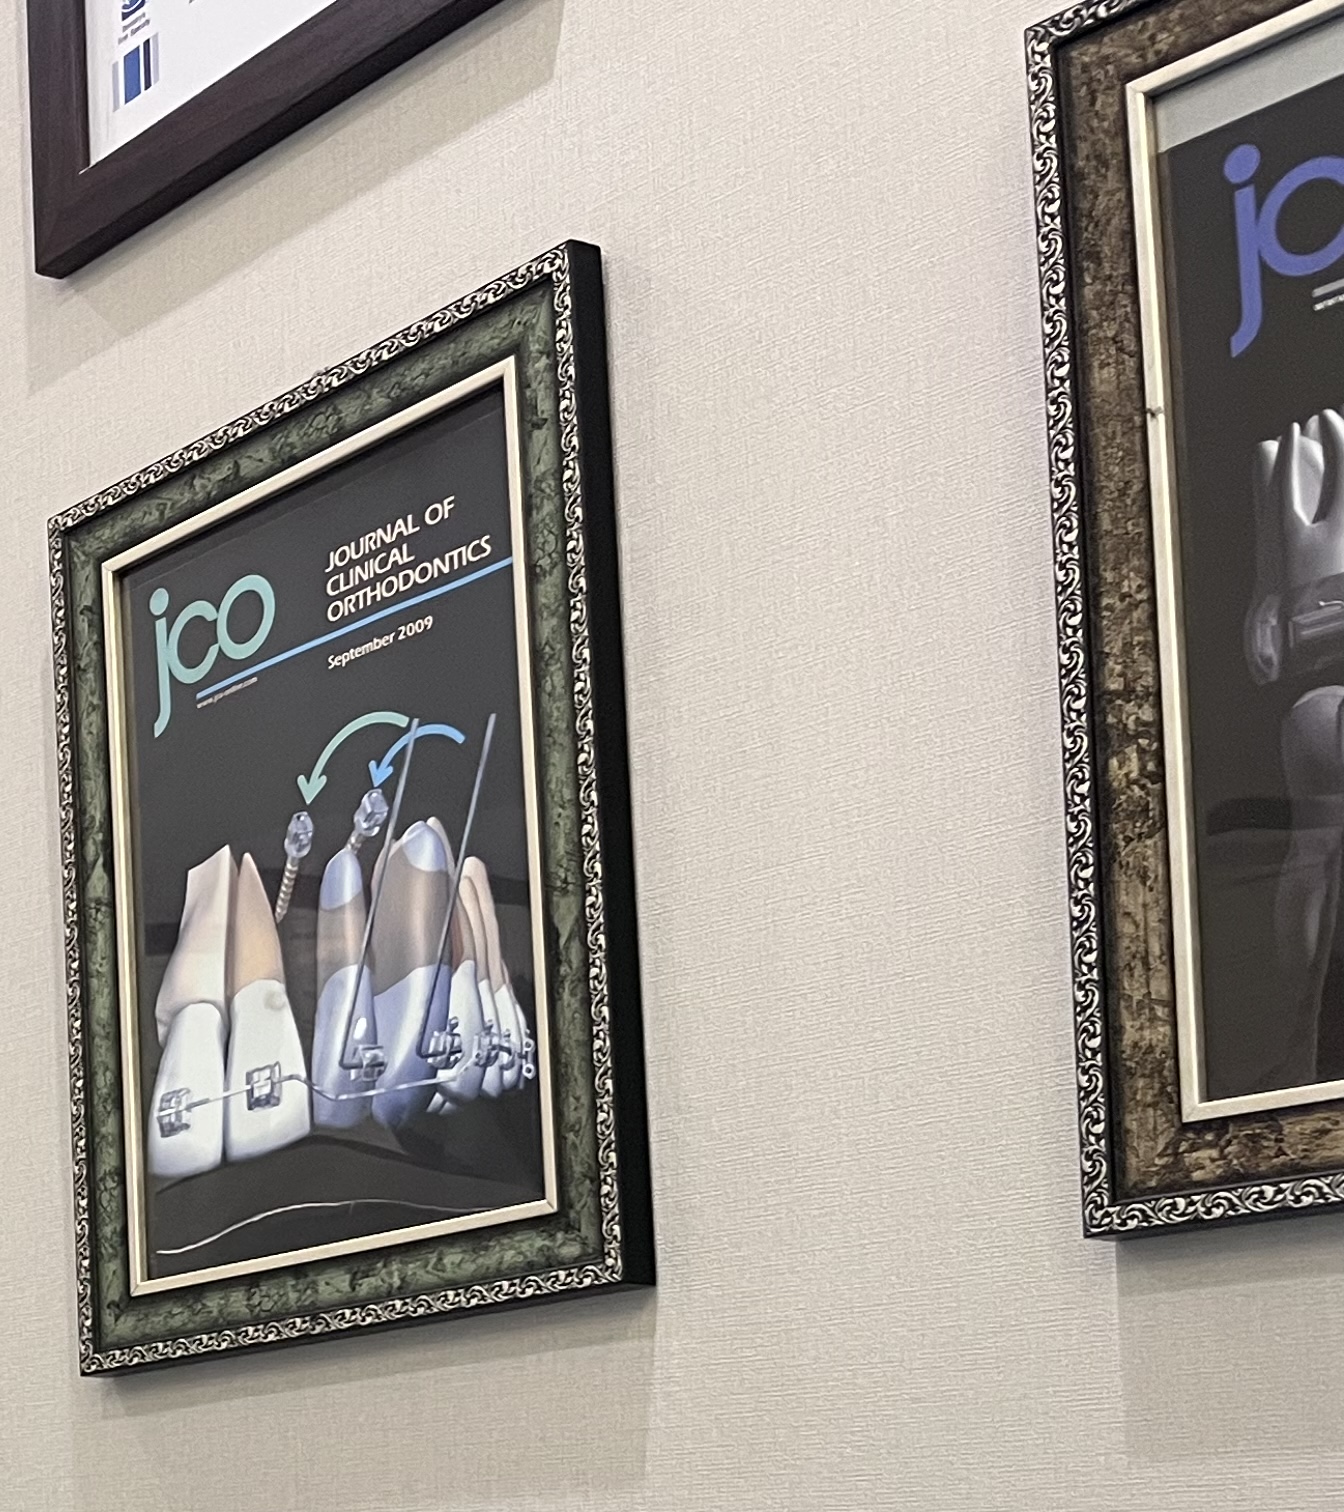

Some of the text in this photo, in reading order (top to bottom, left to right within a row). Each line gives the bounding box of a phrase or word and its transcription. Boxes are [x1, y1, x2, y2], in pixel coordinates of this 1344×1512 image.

[1223, 143, 1344, 358] jc
[325, 495, 456, 573] JOURNAL OF
[326, 542, 415, 597] CLINICAL
[326, 535, 492, 623] ORTHODONTICS
[149, 574, 275, 738] jco
[327, 616, 434, 670] September 2009
